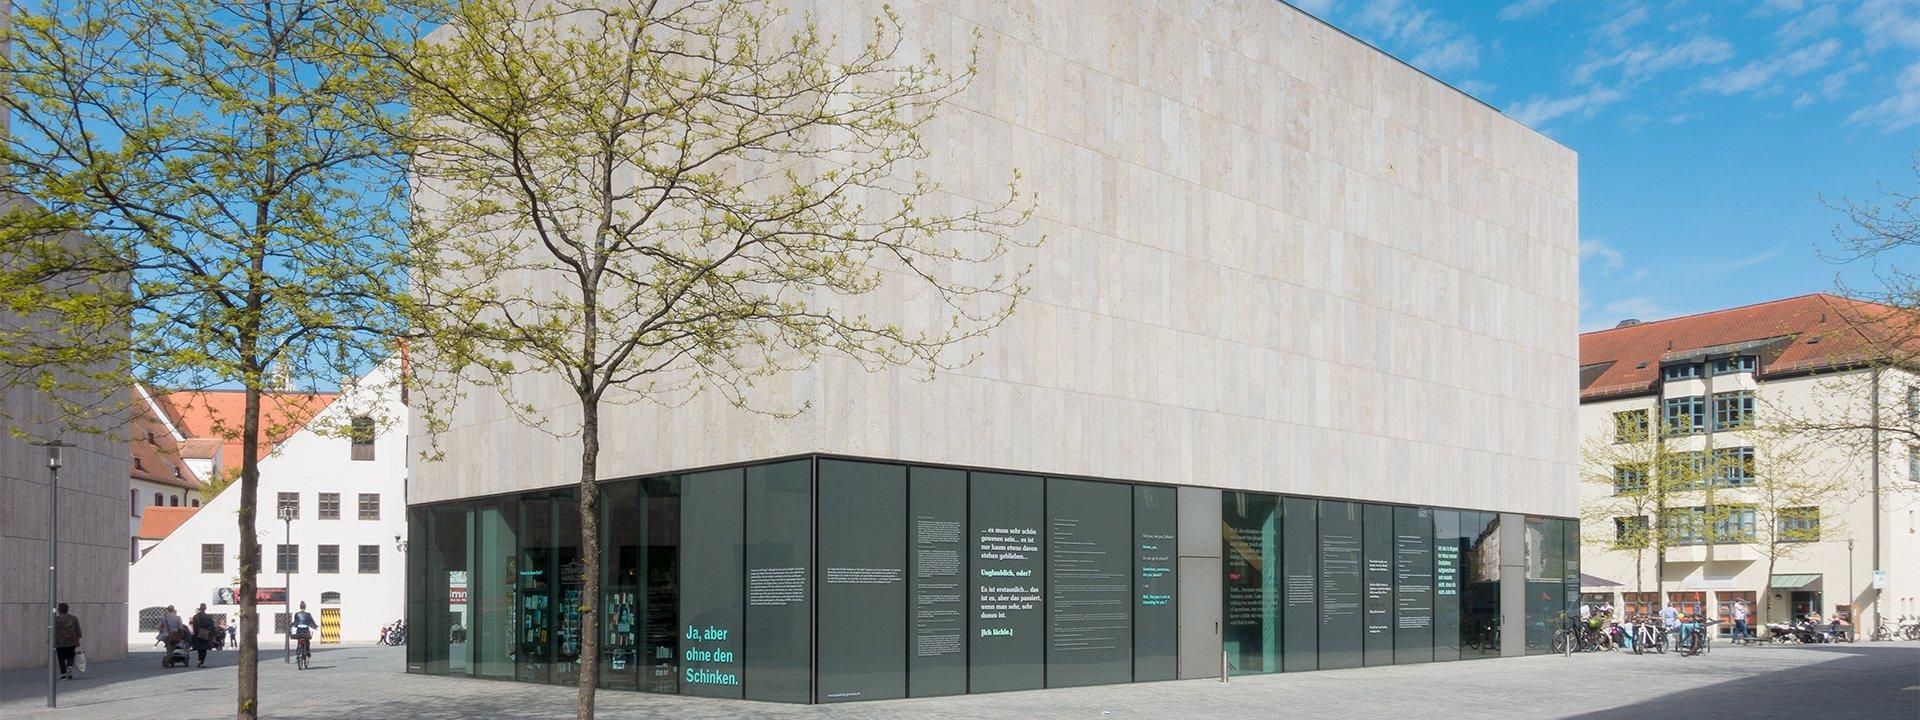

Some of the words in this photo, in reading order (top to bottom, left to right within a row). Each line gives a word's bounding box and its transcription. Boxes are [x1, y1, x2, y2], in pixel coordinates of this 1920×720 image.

[686, 625, 701, 642] Ja,
[704, 626, 727, 640] aber
[686, 647, 711, 661] ohne
[714, 648, 733, 662] den
[686, 668, 739, 685] Schinken.
